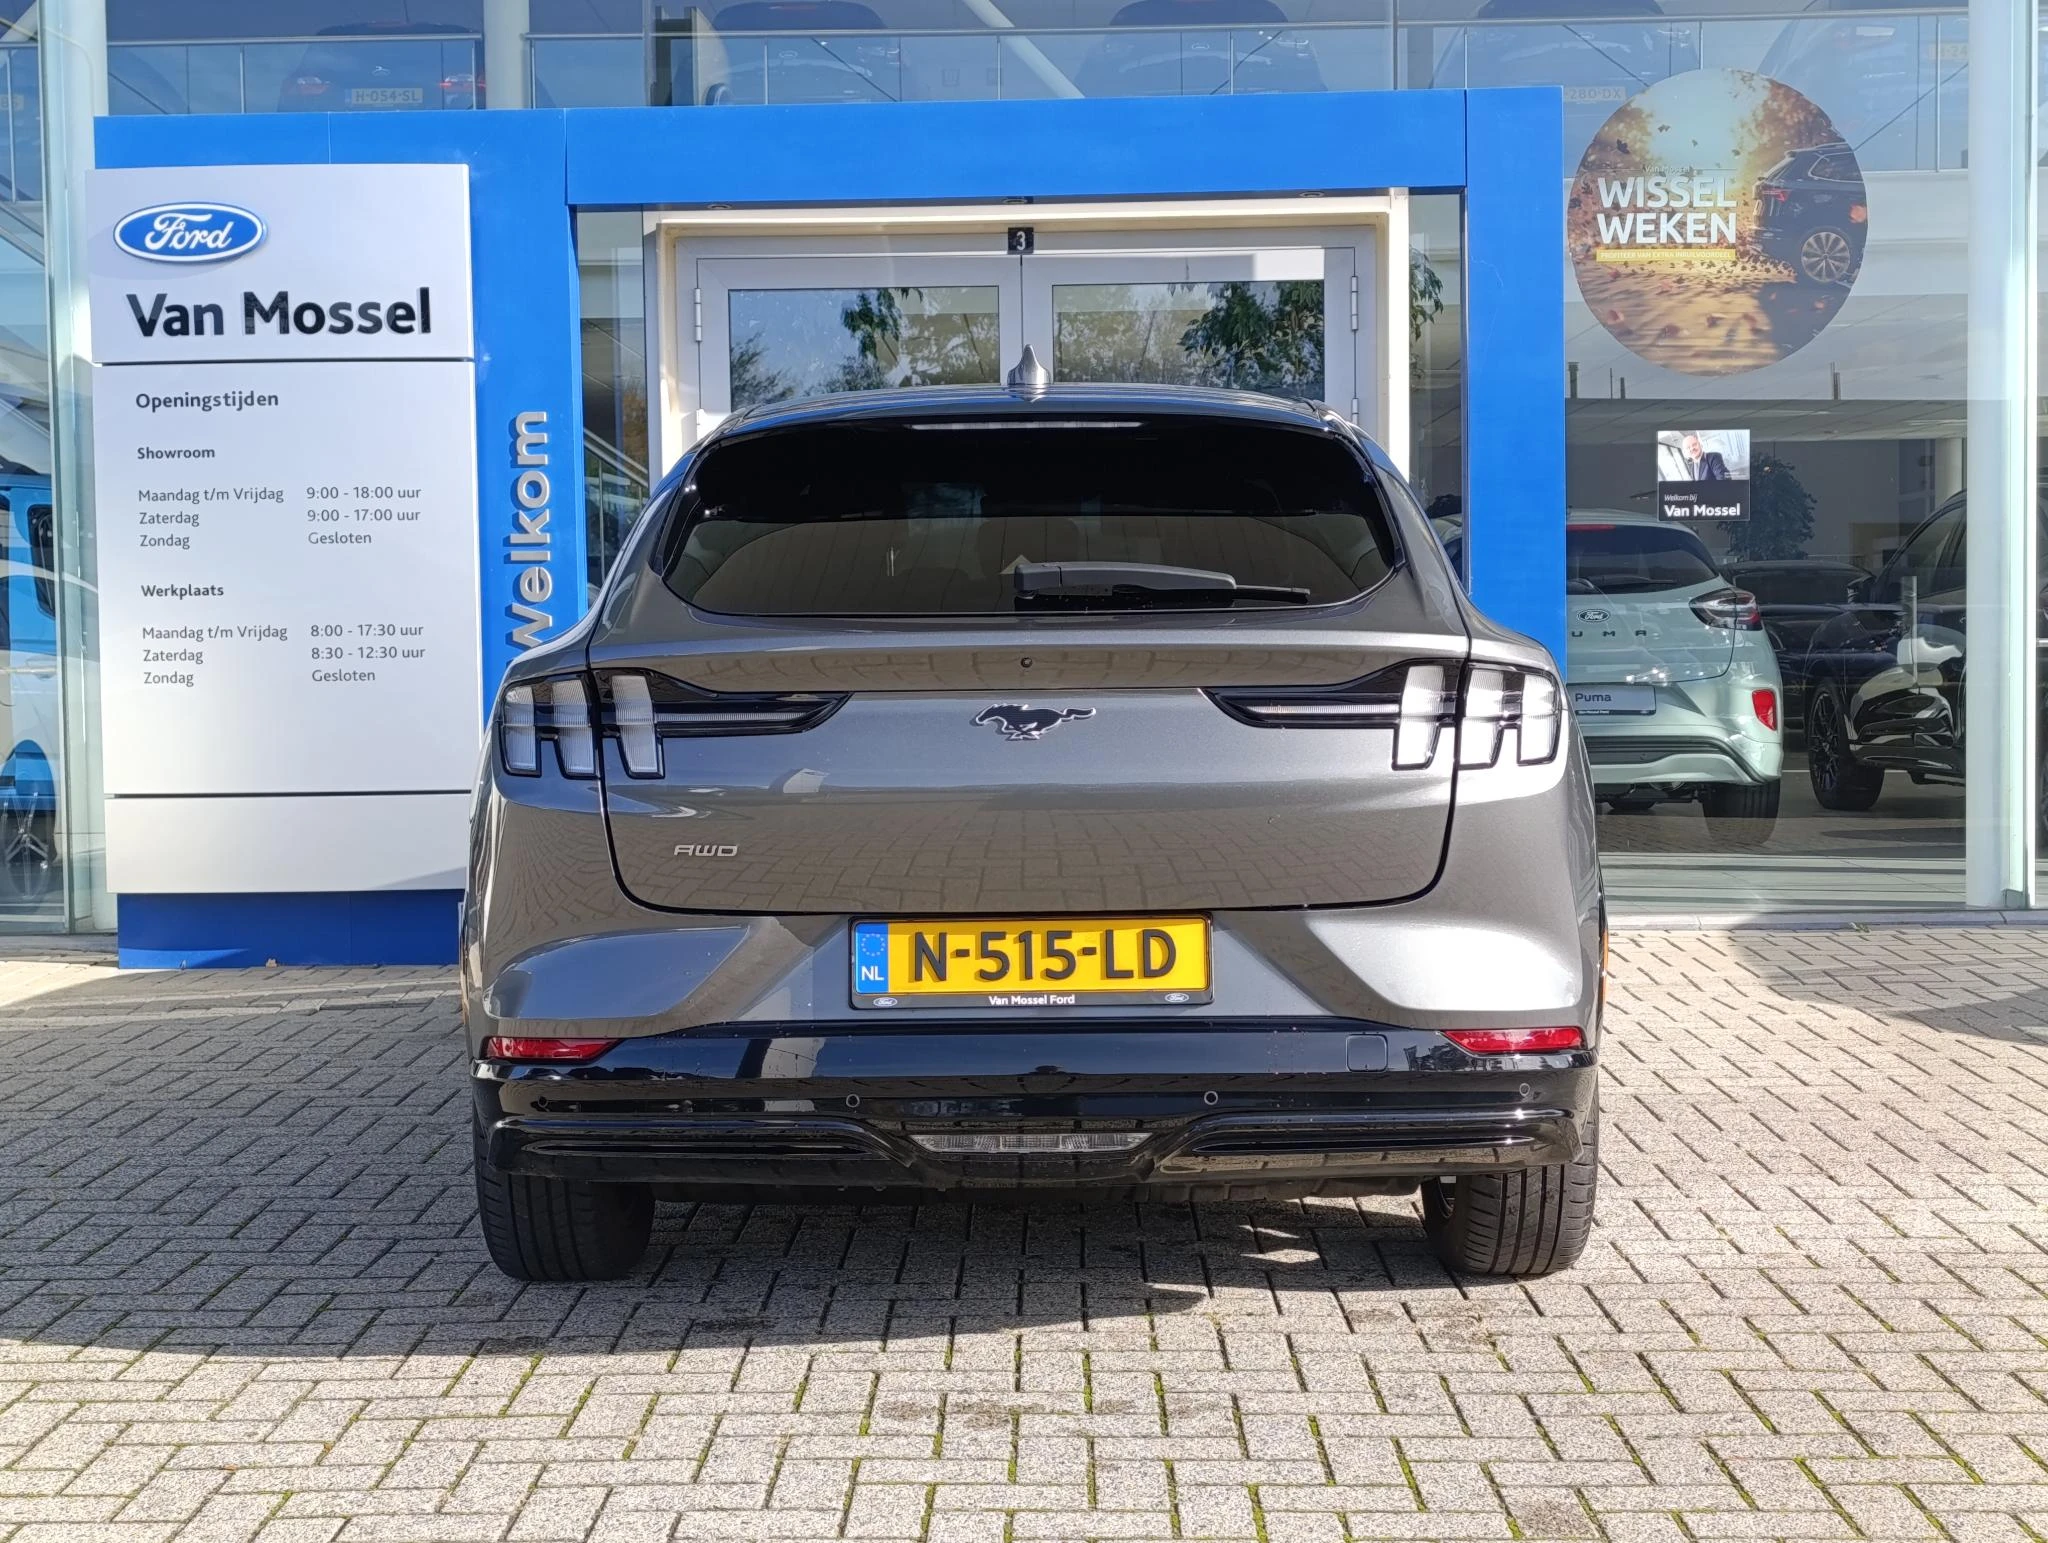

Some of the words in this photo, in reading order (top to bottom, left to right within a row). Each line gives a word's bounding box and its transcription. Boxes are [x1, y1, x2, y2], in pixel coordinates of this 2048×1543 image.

[355, 90, 421, 102] H-054-SL
[1597, 176, 1738, 208] WISSEL
[144, 212, 234, 250] Ford
[1597, 212, 1737, 244] WEKEN
[1016, 231, 1026, 250] 3
[126, 293, 225, 337] Van
[243, 287, 432, 335] Mossel
[135, 391, 279, 413] Openingstijden
[137, 446, 216, 460] Showroom
[138, 487, 199, 504] Maandag
[203, 487, 230, 501] t/m
[233, 486, 285, 503] Vrijdag
[306, 486, 339, 499] 9:00
[353, 486, 394, 499] 18:00
[397, 488, 422, 499] uur
[1664, 493, 1688, 502] Welkom
[139, 510, 200, 527] Zaterdag
[307, 508, 340, 522] 9:00
[353, 508, 393, 522] 17:00
[396, 511, 421, 521] uur
[1663, 504, 1690, 518] Van
[1693, 502, 1741, 517] Mossel
[509, 411, 553, 649] Welkom
[139, 533, 191, 550] Zondag
[308, 531, 372, 545] Gesloten
[140, 583, 225, 600] Werkplaats
[142, 625, 204, 642] Maandag
[207, 625, 233, 639] t/m
[236, 624, 288, 641] Vrijdag
[310, 624, 344, 637] 8:00
[357, 623, 396, 637] 17:30
[400, 626, 424, 636] uur
[1571, 630, 1647, 638] UMA
[143, 648, 204, 665] Zaterdag
[311, 646, 344, 660] 8:30
[357, 646, 398, 659] 12:30
[401, 648, 426, 659] uur
[143, 670, 195, 687] Zondag
[311, 668, 376, 682] Gesloten
[1575, 693, 1612, 702] Puma
[674, 844, 738, 857] AWD
[913, 929, 1177, 983] N-515-LD
[861, 966, 884, 981] NL
[988, 995, 1009, 1006] Van
[1011, 994, 1048, 1006] Mossel
[1049, 994, 1075, 1005] Ford
